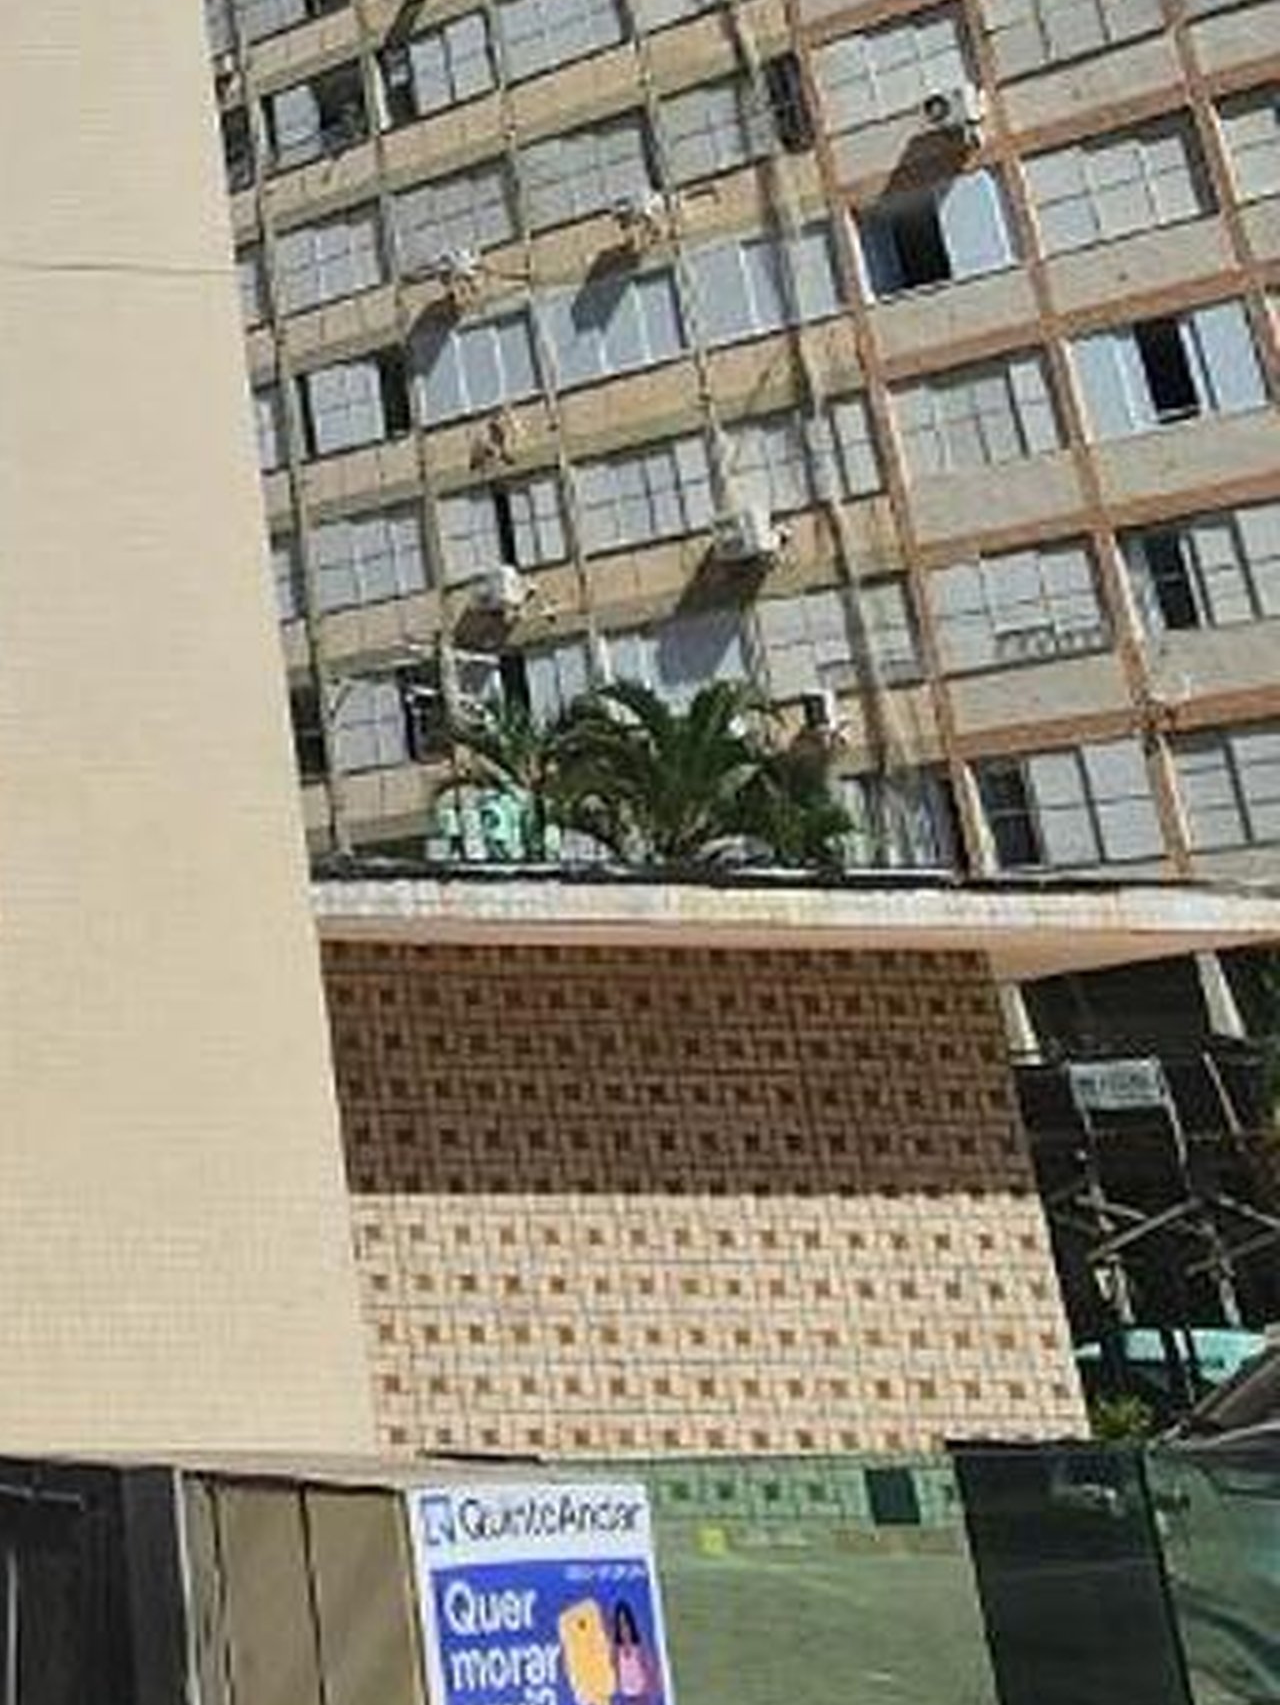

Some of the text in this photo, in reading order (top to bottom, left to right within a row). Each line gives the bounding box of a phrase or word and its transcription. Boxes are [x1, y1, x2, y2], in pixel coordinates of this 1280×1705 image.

[458, 1495, 643, 1540] QuintoAndar
[444, 1581, 537, 1635] Quer
[450, 1643, 561, 1692] morar
